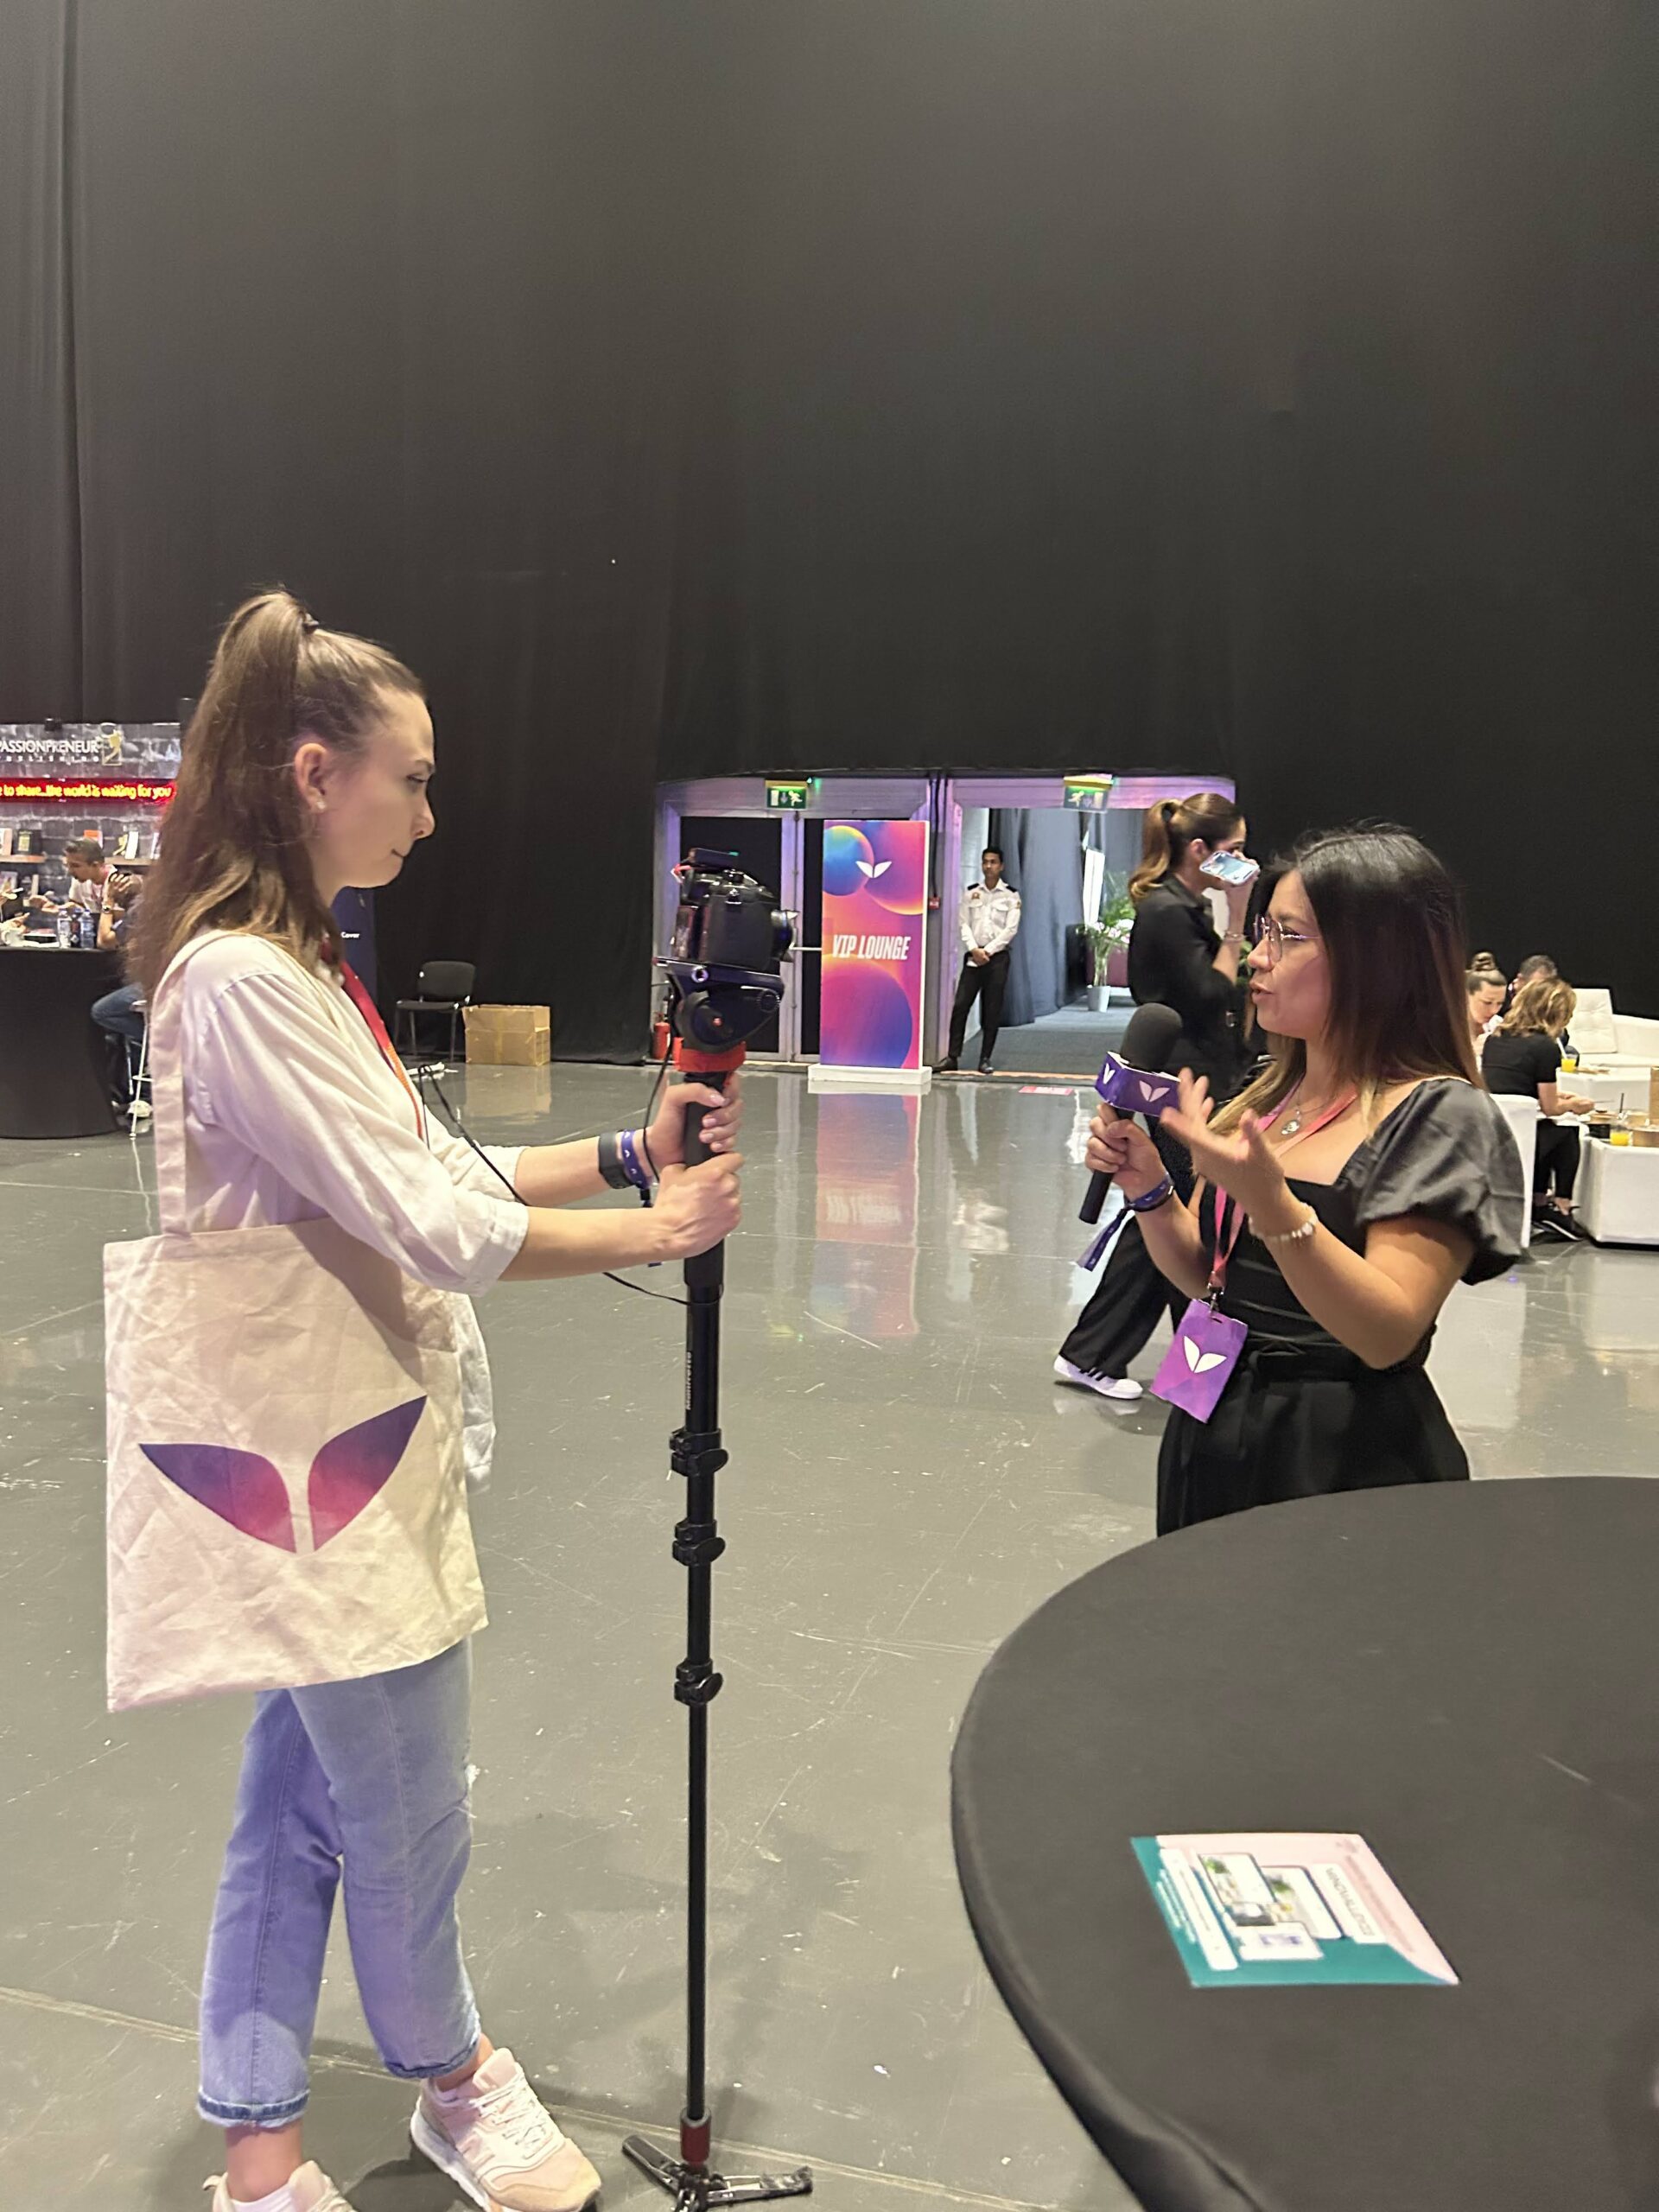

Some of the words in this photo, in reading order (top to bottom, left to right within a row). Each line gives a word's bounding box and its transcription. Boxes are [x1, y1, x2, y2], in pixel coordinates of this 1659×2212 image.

[3, 785, 15, 797] to
[101, 785, 137, 800] waiting
[137, 784, 152, 797] for
[152, 787, 172, 800] you
[832, 934, 857, 959] VIP
[857, 935, 912, 961] LOUNGE
